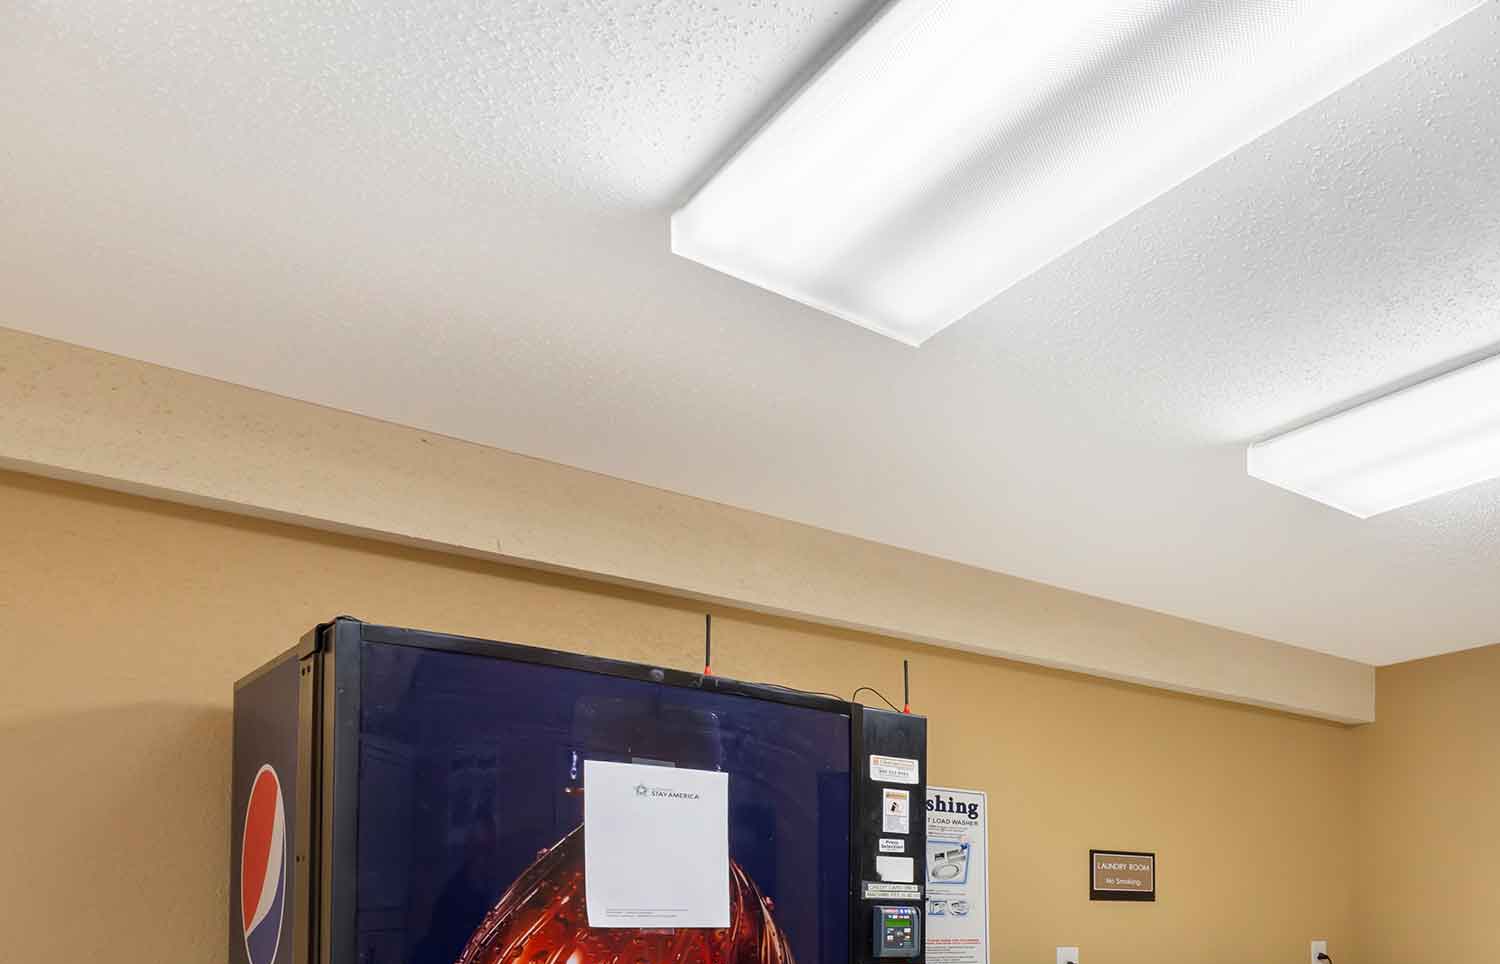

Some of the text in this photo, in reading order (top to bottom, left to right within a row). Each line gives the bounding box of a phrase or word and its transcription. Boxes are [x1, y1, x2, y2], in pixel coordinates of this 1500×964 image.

[668, 792, 700, 800] AMERICA
[1097, 863, 1151, 872] LAUNDRY ROOM
